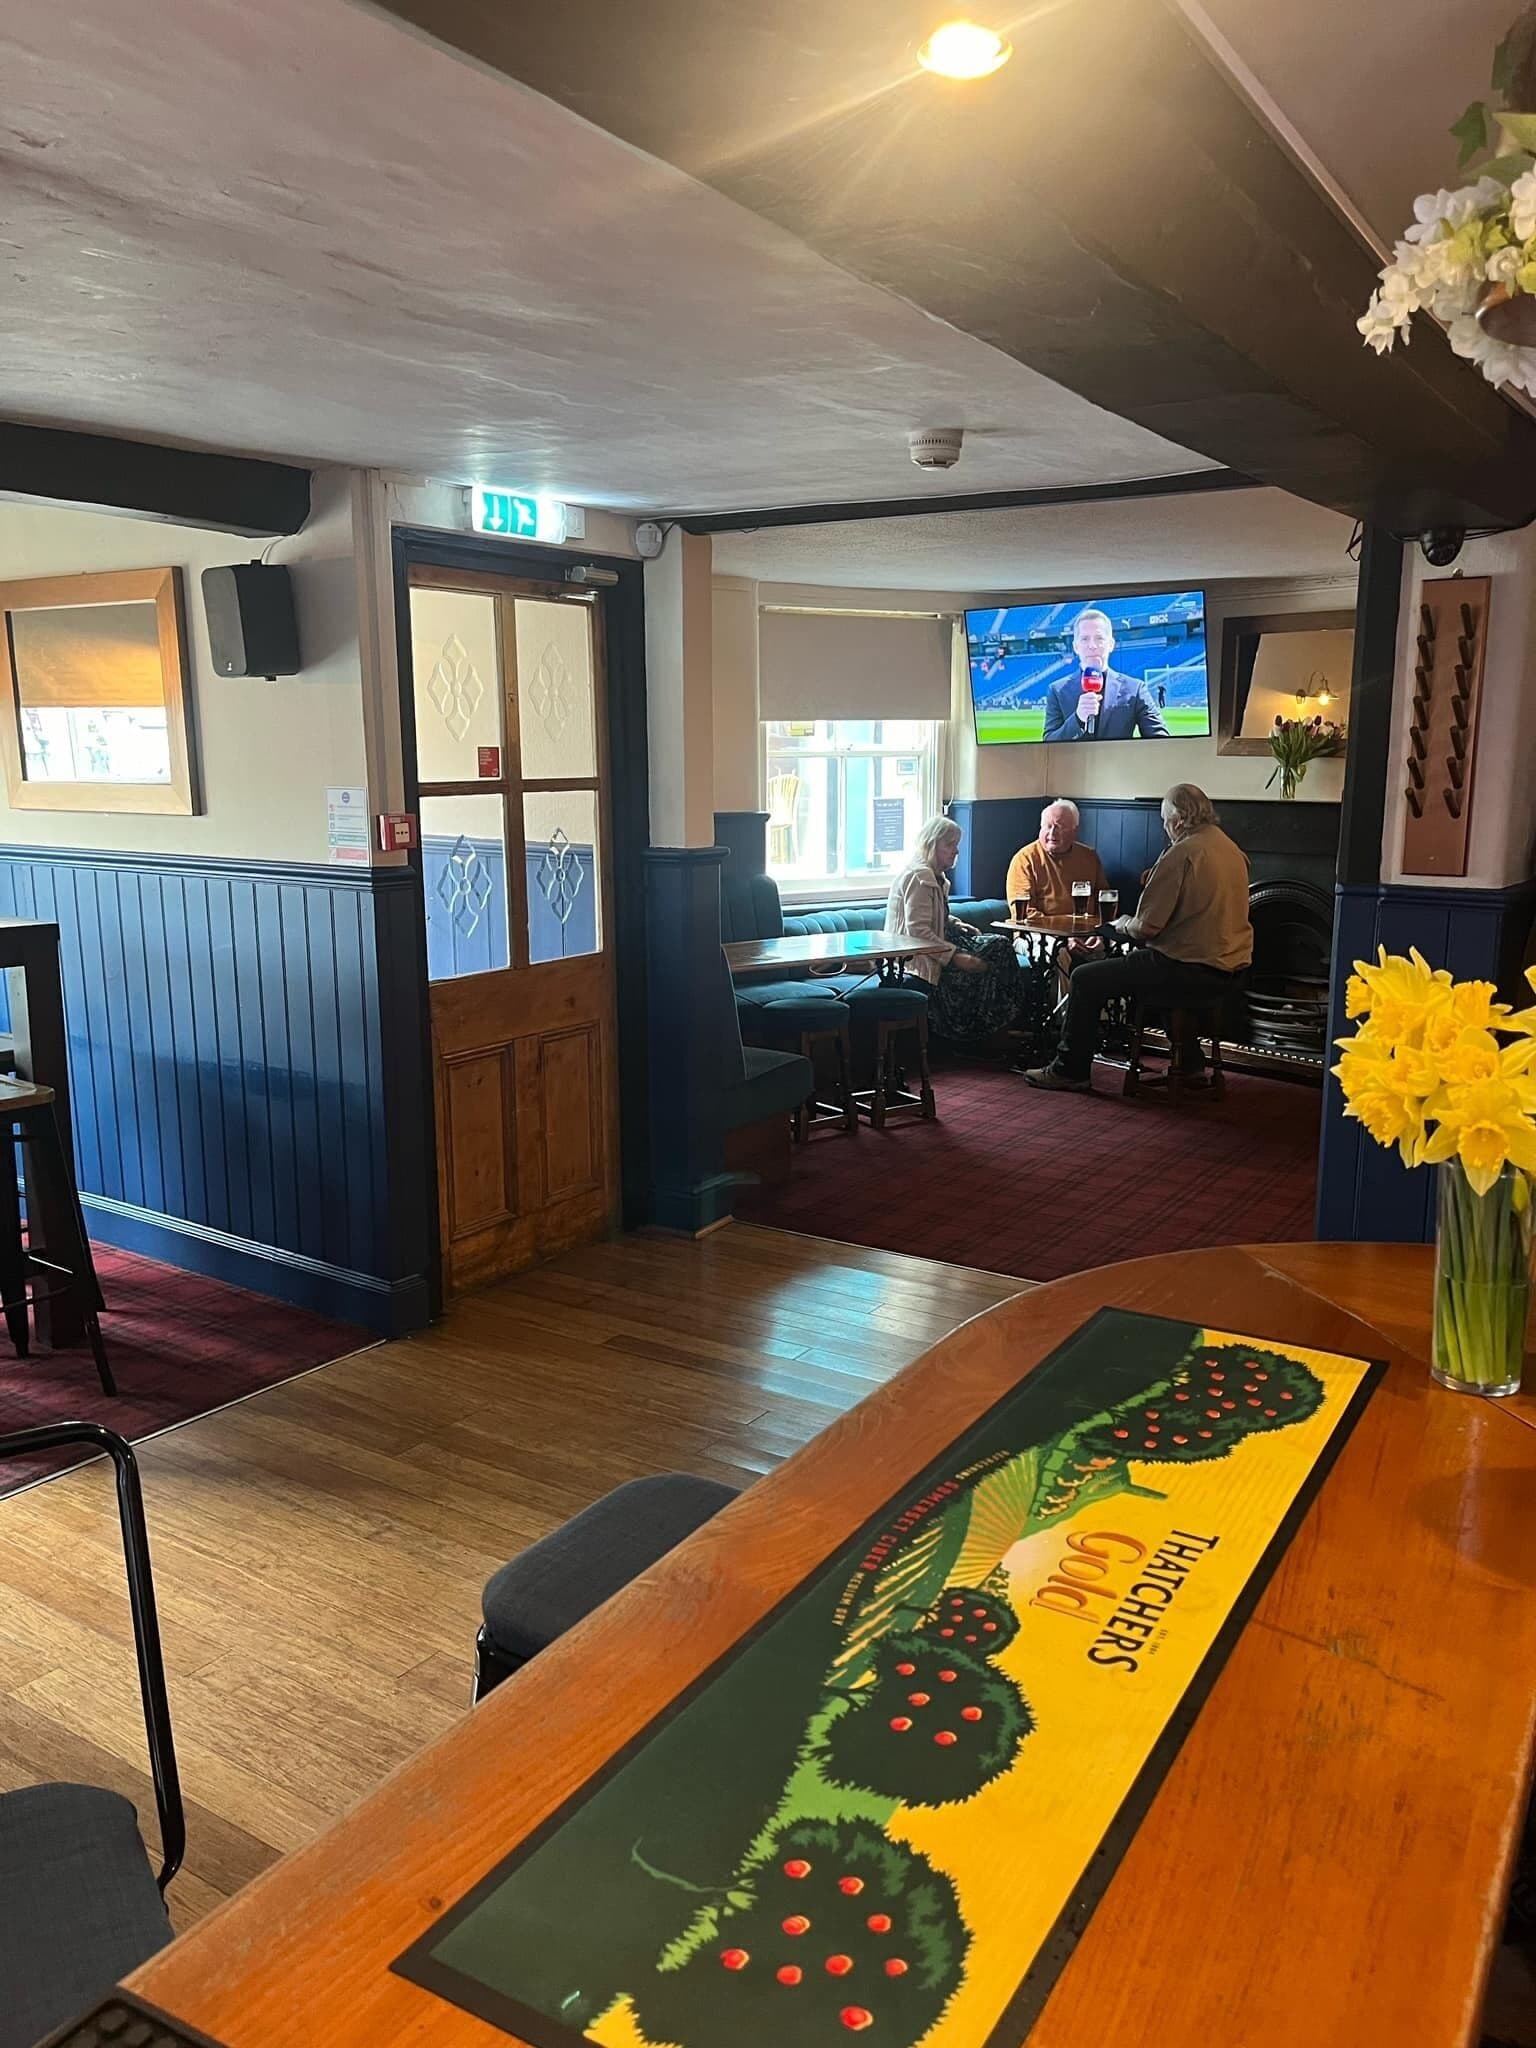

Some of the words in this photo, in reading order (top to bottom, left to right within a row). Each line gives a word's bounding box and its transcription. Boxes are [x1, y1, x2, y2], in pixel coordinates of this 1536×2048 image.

[892, 1480, 960, 1533] SOMERSET
[860, 1534, 898, 1571] CIDER
[1028, 1531, 1148, 1625] Gold
[1087, 1529, 1220, 1673] THATCHERS
